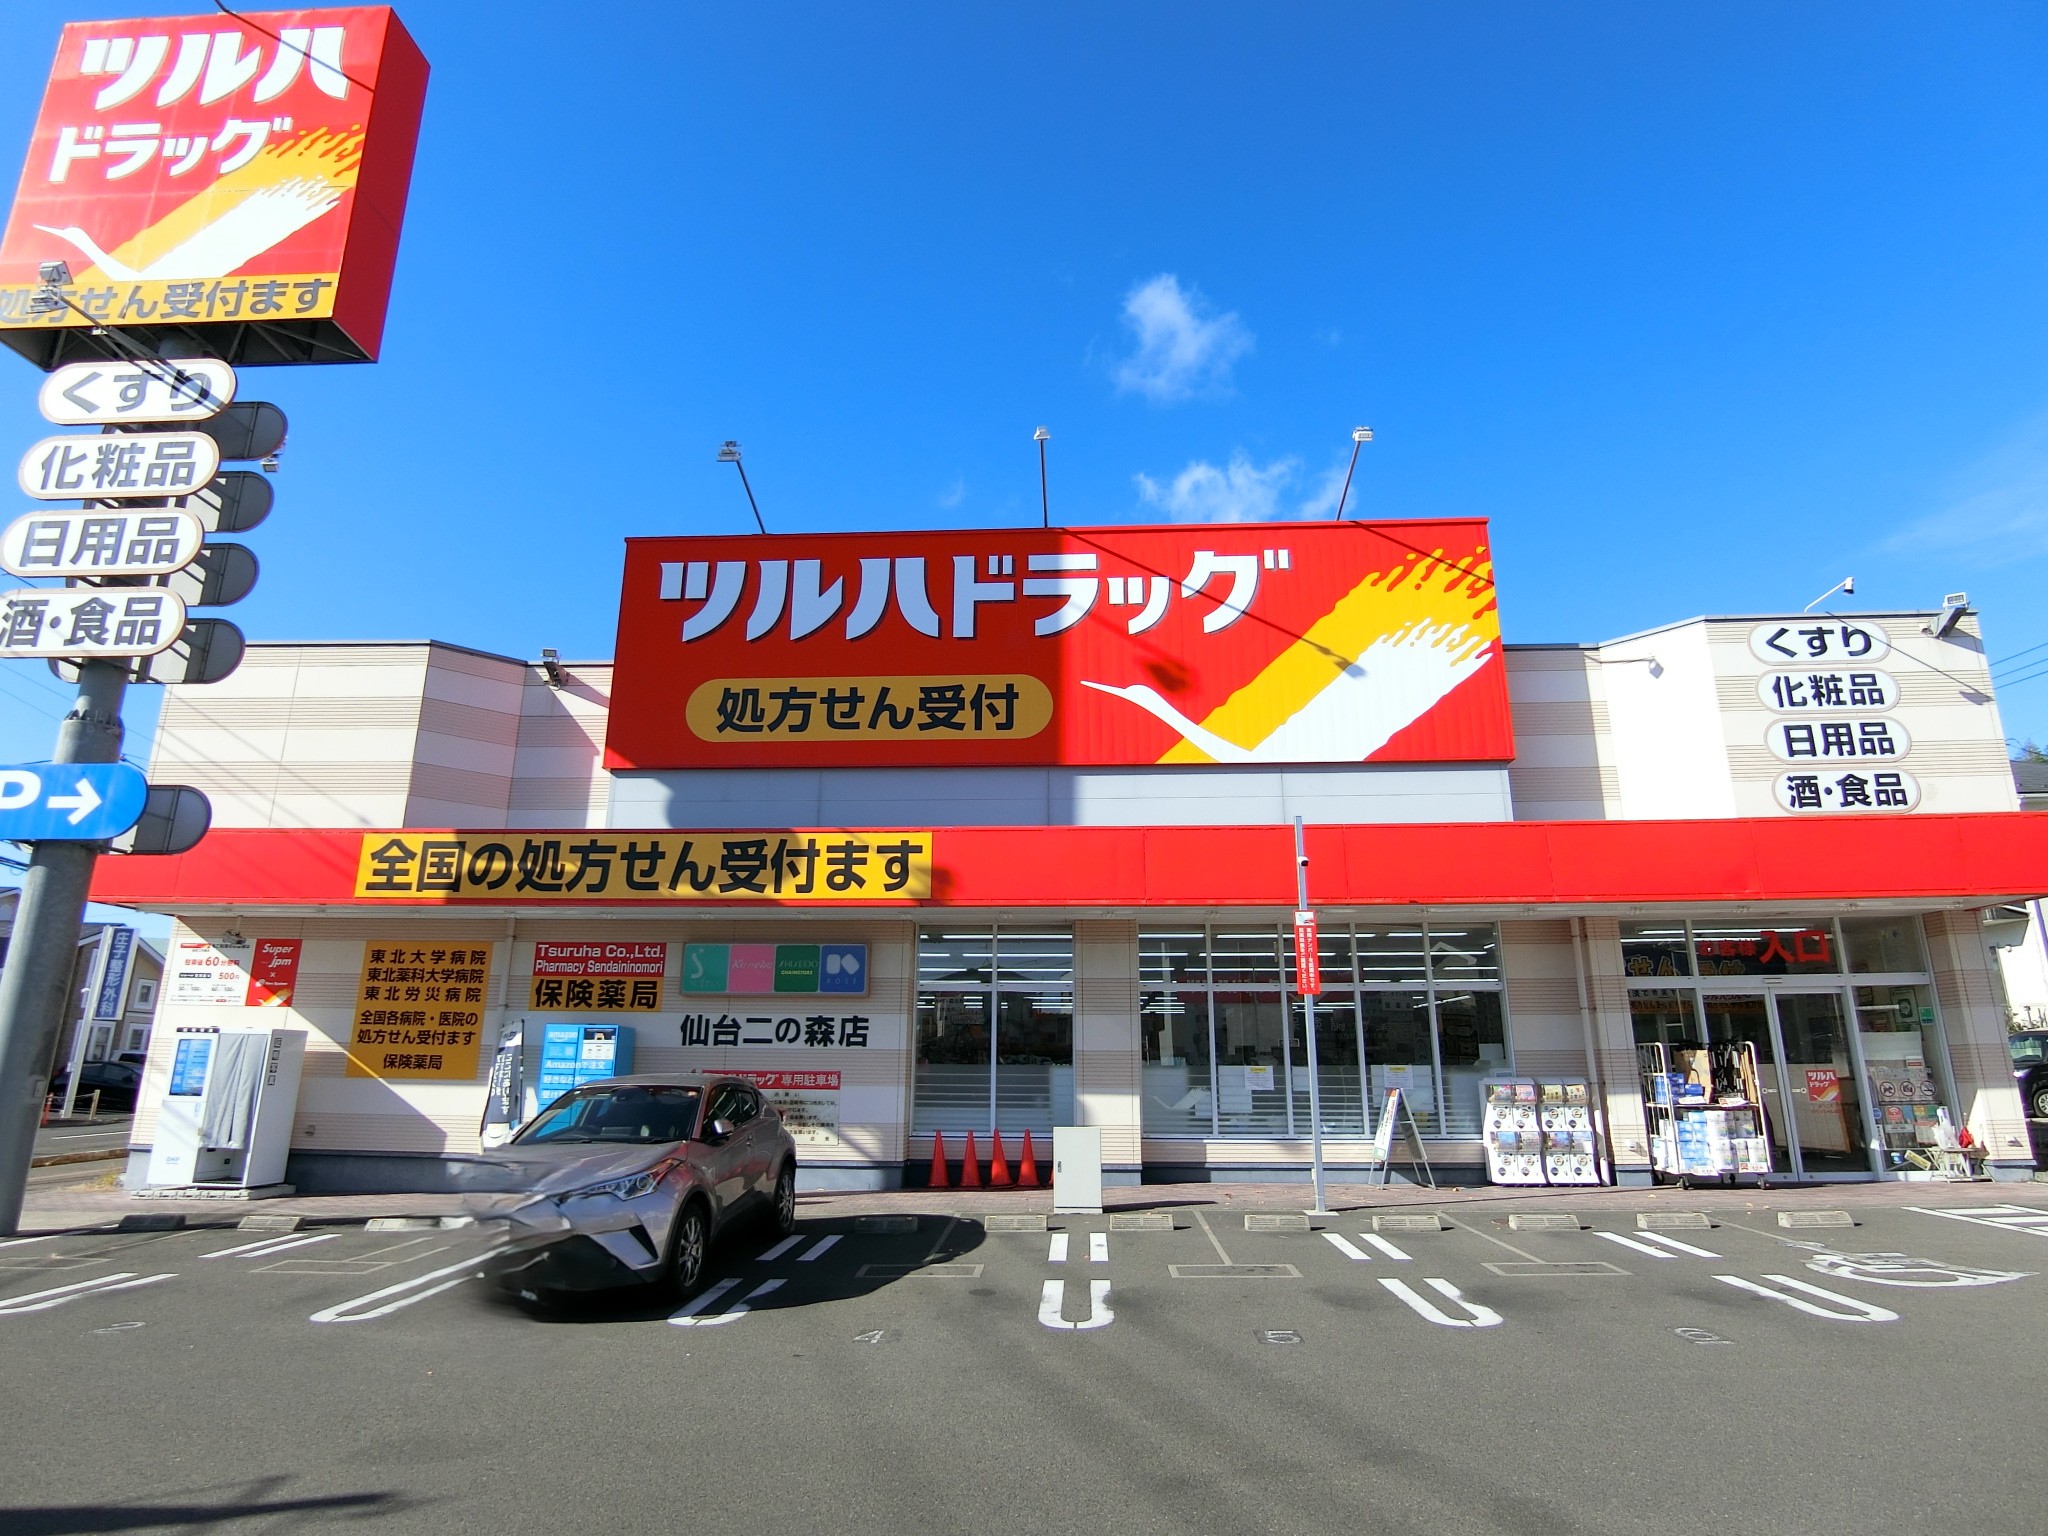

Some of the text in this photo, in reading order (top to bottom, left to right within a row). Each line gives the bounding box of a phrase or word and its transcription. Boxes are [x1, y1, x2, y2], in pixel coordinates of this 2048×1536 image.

[80, 27, 351, 110] ツルハ
[48, 117, 293, 182] ドラッグ
[62, 369, 213, 414] くすり
[40, 440, 197, 491] 化粧品
[19, 516, 181, 567] 日用品
[660, 549, 1291, 643] ツルハドラッグ
[1765, 626, 1873, 658] くすり
[1772, 673, 1886, 708] 化粧品
[716, 684, 1020, 734] 処方せん受付
[1783, 722, 1896, 758] 日用品
[1787, 773, 1909, 809] 酒・食品
[364, 838, 924, 894] 全国の処方せん受付ます
[262, 943, 294, 955] Super
[268, 956, 292, 968] jpm
[370, 949, 487, 966] 東北大学病院
[538, 944, 664, 959] Tsuruha Co.,Ltd.
[1759, 930, 1831, 964] 入口
[366, 967, 484, 984] 東北薬科大学病院
[535, 959, 663, 975] Pharmacy Sendaininomori
[364, 986, 482, 1003] 東北労災病院
[535, 978, 658, 1009] 保険薬局
[359, 1009, 478, 1027] 全国各病院・医院の
[680, 1013, 870, 1047] 仙台二の森店
[357, 1029, 477, 1046] 処方せん受付ます
[383, 1053, 443, 1070] 保険薬局
[1807, 1071, 1836, 1081] ツルハ
[781, 1073, 839, 1087] 専用駐車場
